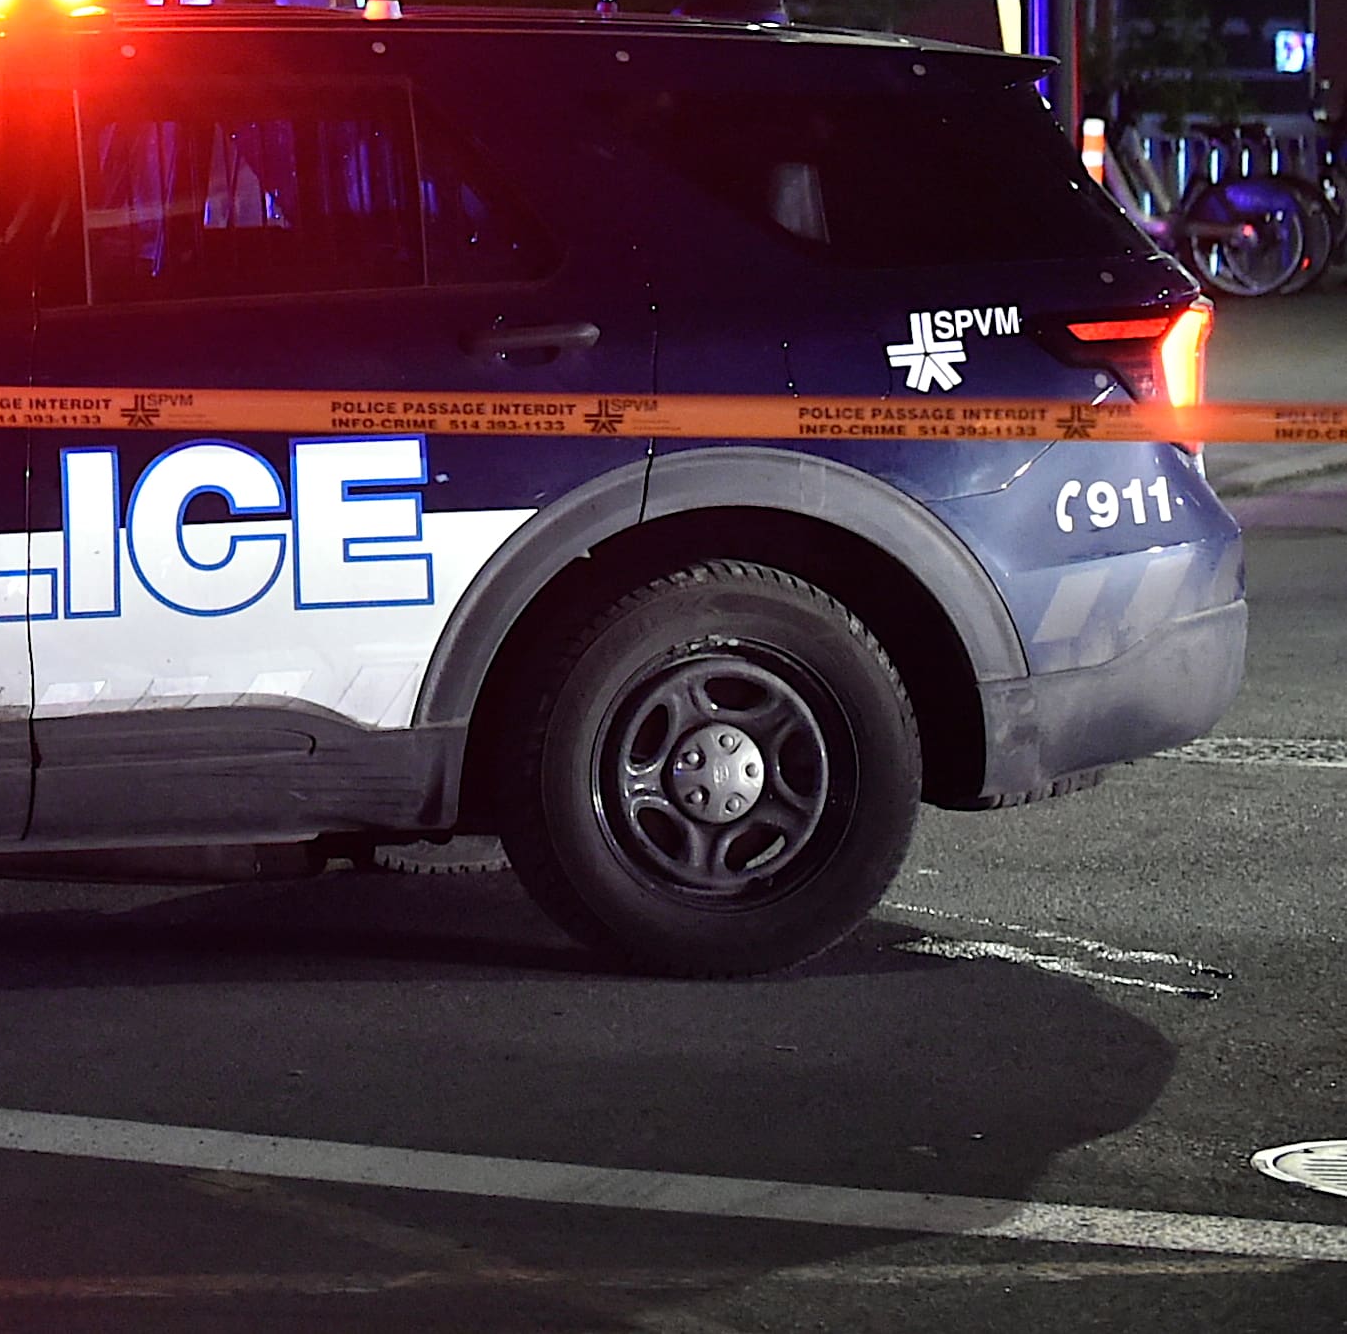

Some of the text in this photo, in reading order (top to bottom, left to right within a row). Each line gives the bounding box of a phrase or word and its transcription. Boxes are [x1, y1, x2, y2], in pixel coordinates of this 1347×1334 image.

[933, 306, 1021, 339] SPVM
[28, 398, 112, 411] INTERDIT
[147, 393, 193, 407] SPVM
[611, 398, 658, 412] SPVM
[331, 401, 577, 416] POLICE PASSAGE INTERDIT
[798, 407, 1048, 422] POLICE PASSAGE INTERDIT
[1274, 411, 1342, 424] POLICE
[332, 418, 565, 432] INFO-CRIME 514 393-1133
[799, 424, 1037, 437] INFO-CRIME 514 393-1133
[1086, 475, 1173, 530] 911
